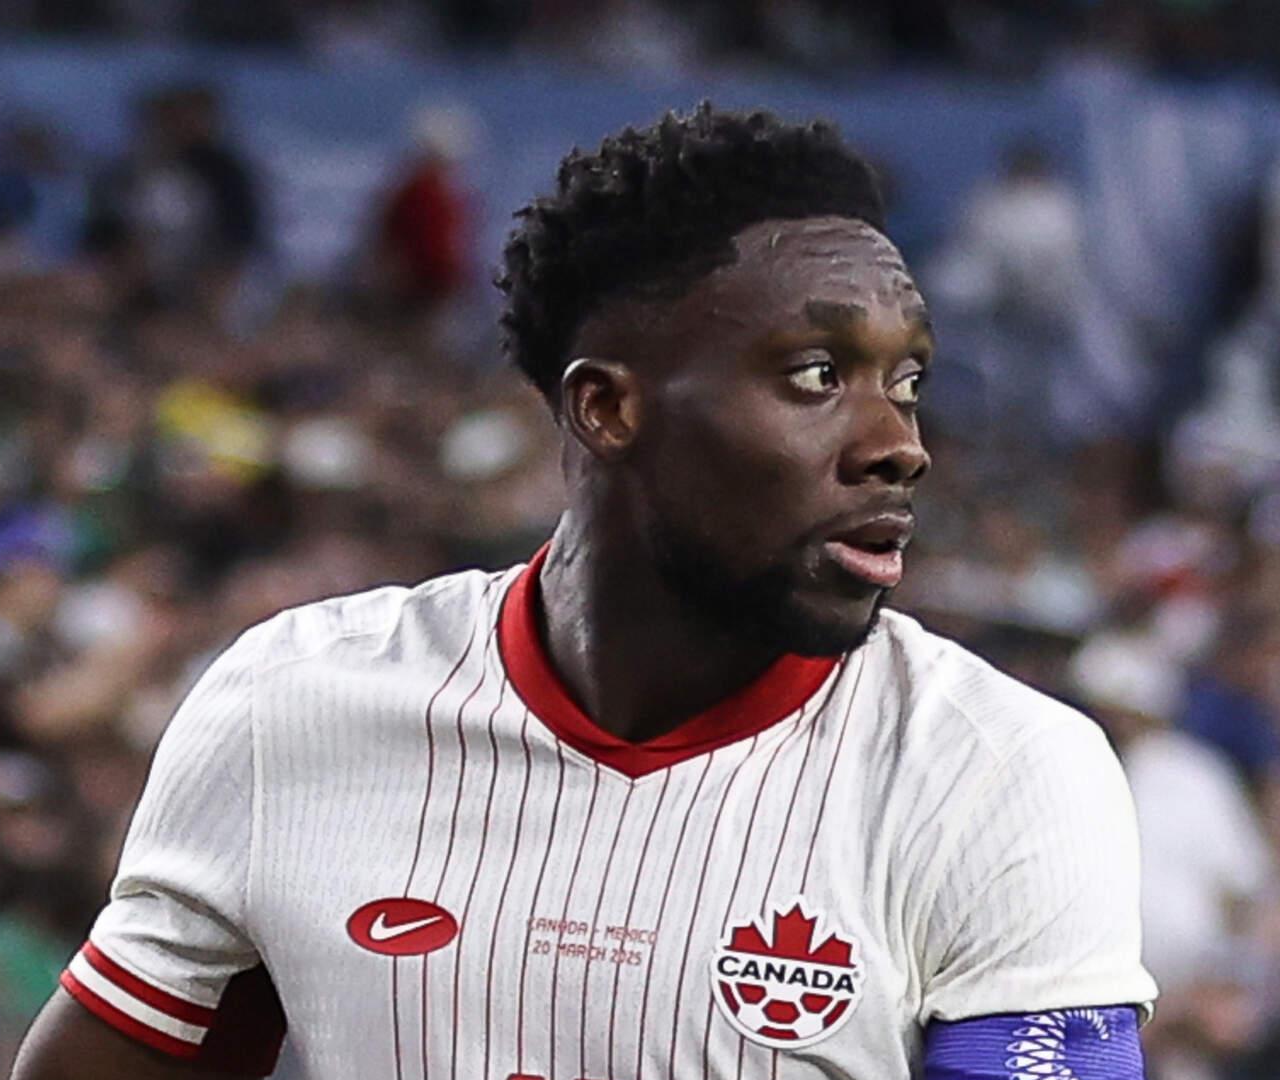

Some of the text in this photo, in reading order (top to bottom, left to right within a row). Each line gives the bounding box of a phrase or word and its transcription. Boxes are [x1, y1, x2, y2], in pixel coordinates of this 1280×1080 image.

[526, 916, 589, 936] CANADA
[605, 925, 658, 946] MEXICO
[532, 939, 643, 967] 20 MARCH 2025
[717, 955, 856, 994] CANADA
